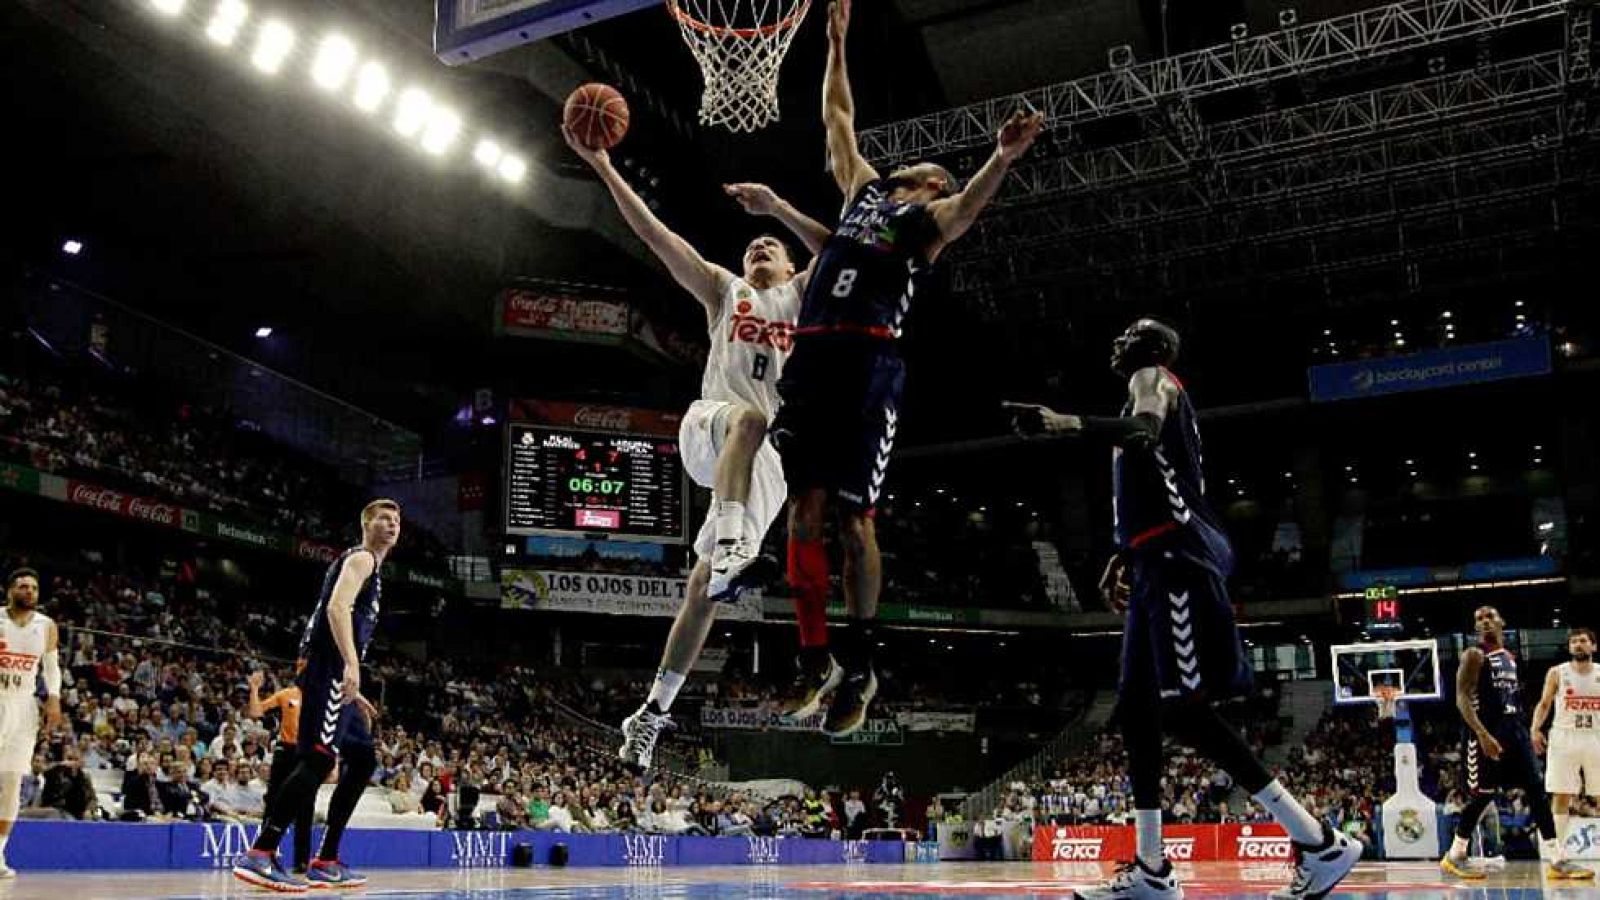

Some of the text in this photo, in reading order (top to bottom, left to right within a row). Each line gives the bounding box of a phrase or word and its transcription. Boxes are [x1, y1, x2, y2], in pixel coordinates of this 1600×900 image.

[831, 269, 857, 297] 8
[1376, 361, 1455, 384] barclaycard
[569, 477, 624, 494] 06:07
[548, 574, 582, 592] LOS
[587, 577, 633, 595] OJOS
[637, 579, 672, 598] DEL
[1377, 600, 1395, 619] 14
[451, 832, 513, 859] MMT
[622, 835, 667, 858] MMT
[1052, 837, 1103, 859] Teka
[1236, 836, 1292, 858] Teka
